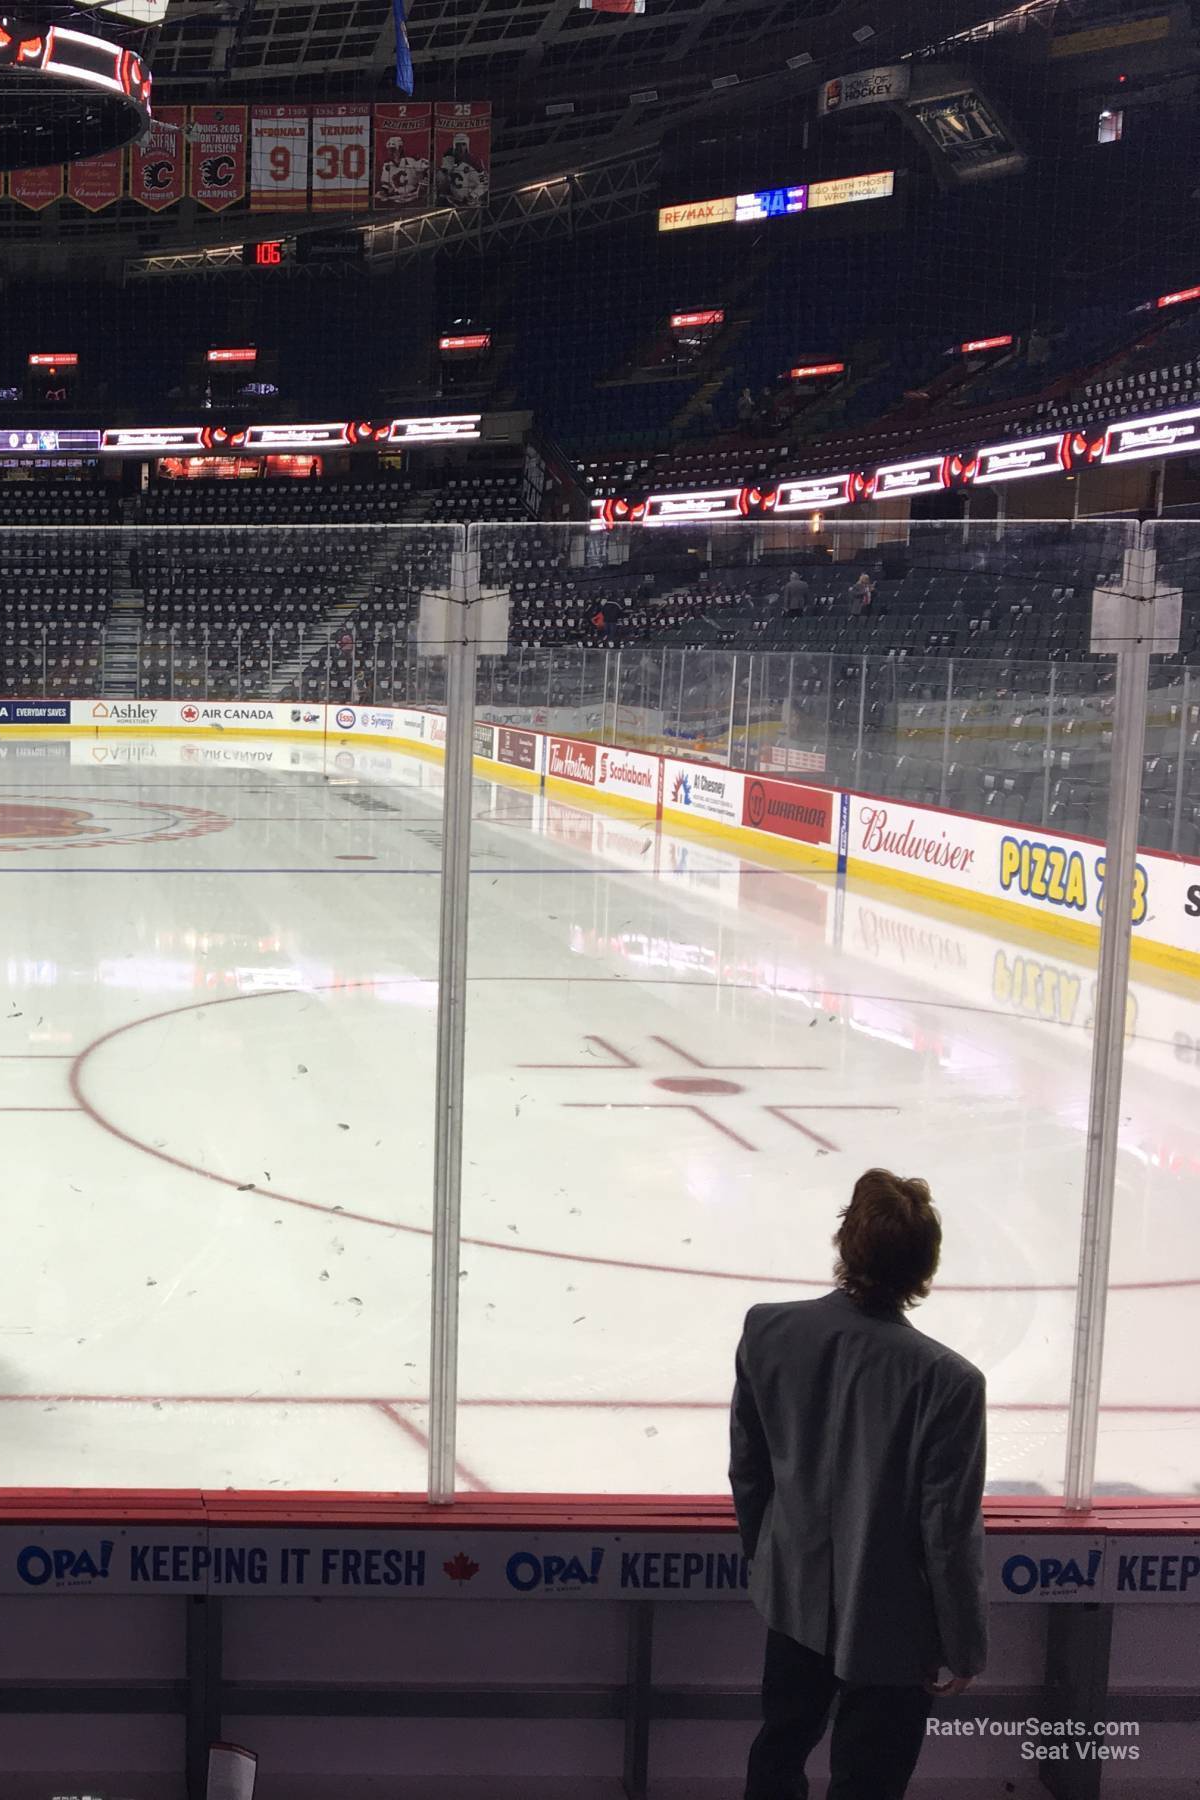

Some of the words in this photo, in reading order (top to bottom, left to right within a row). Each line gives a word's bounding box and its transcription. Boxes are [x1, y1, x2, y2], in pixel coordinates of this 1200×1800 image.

[844, 83, 893, 103] HOCKEY
[399, 106, 408, 117] 2
[454, 103, 472, 116] 25
[319, 125, 365, 136] VERNON
[269, 145, 291, 182] 9
[316, 144, 366, 180] 30
[857, 177, 888, 187] THOSE
[197, 190, 238, 199] CHAMPIONS
[255, 243, 281, 265] 106
[16, 707, 46, 718] EVERYDAY
[47, 707, 67, 718] SAVES
[109, 702, 158, 722] Ashley
[201, 708, 221, 720] AIR
[223, 708, 274, 721] CANADA
[339, 713, 354, 724] Esso
[370, 714, 394, 730] Synergy
[551, 743, 564, 775] Tim
[563, 744, 595, 782] Hortons
[609, 761, 653, 788] Scotiabank
[700, 775, 726, 799] Chesney
[767, 798, 826, 828] WARRIOR
[859, 805, 976, 872] Budweiser
[1000, 835, 1087, 912] PIZZA
[16, 1540, 115, 1586] OPA!
[129, 1546, 268, 1586] KEEPING
[281, 1547, 311, 1586] IT
[321, 1548, 426, 1587] FRESH
[505, 1547, 605, 1592] OPA!
[1001, 1549, 1103, 1595] OPA!
